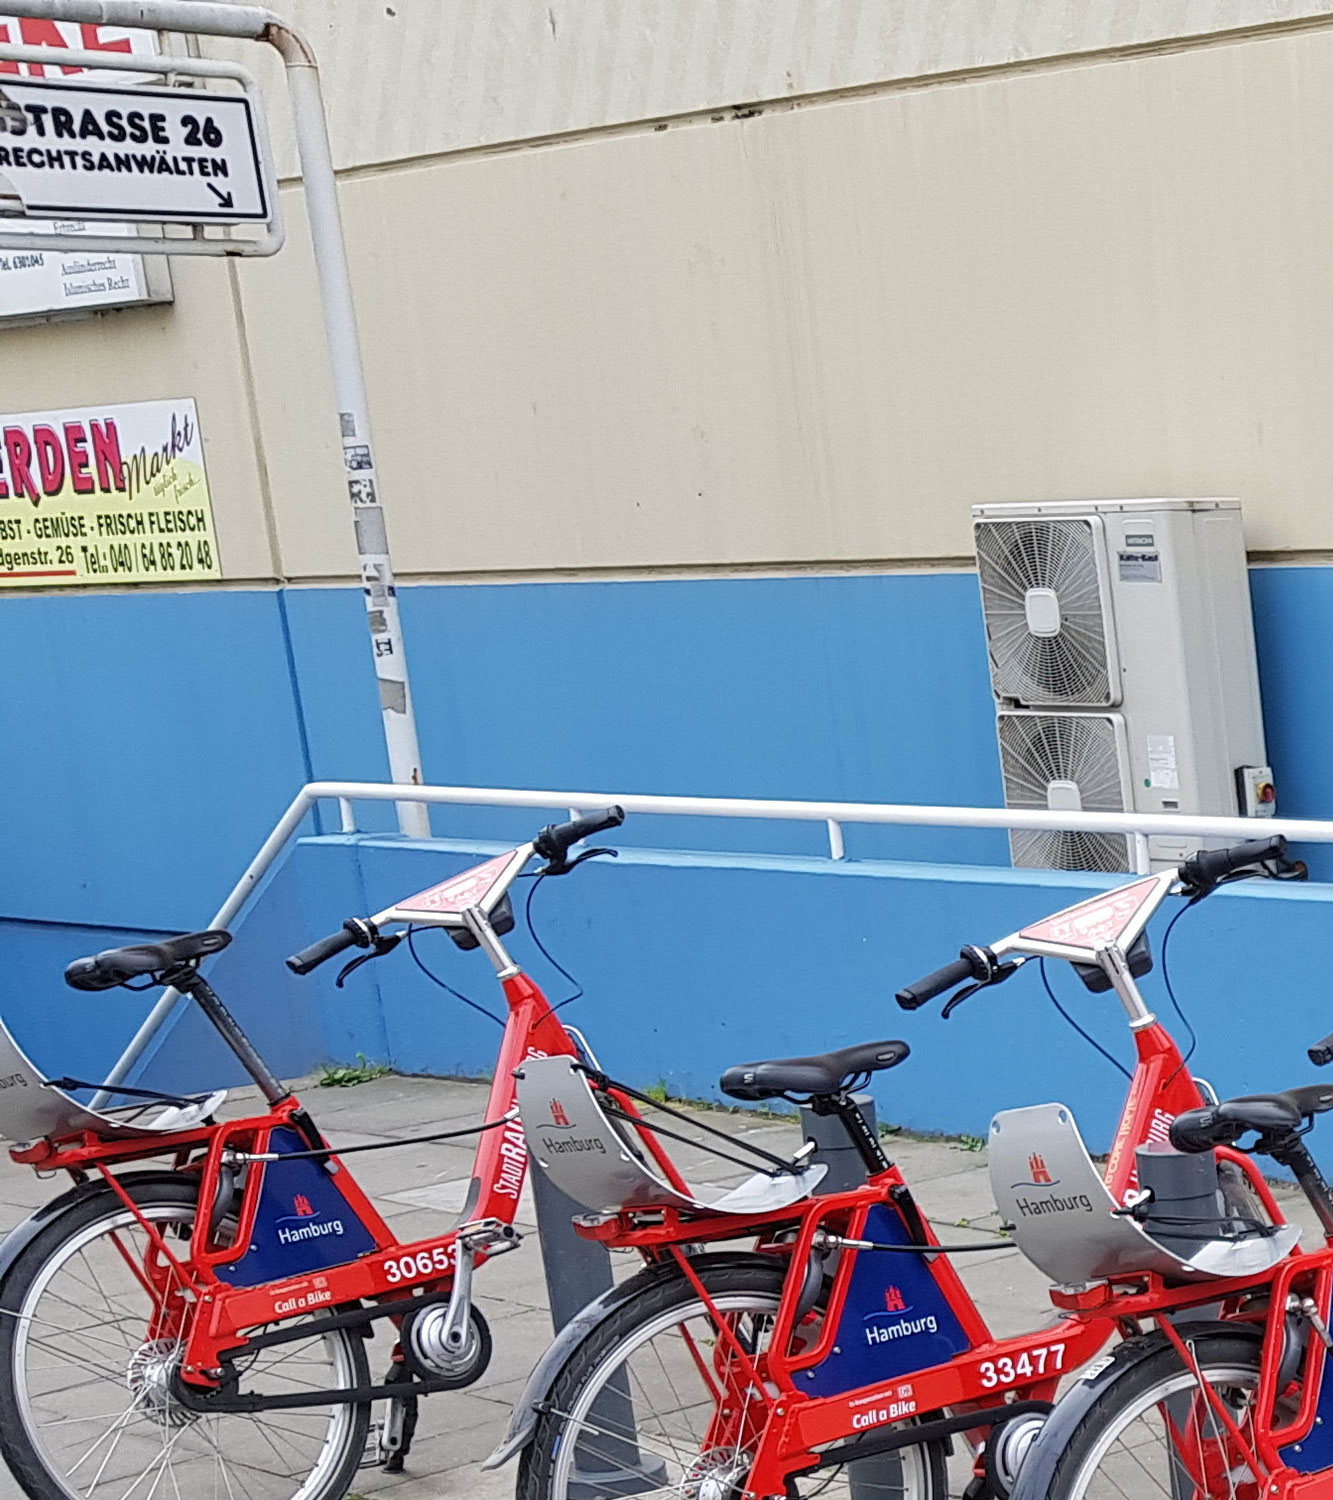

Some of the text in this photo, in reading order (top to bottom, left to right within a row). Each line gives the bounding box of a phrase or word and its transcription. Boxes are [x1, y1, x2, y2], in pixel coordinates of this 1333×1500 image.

[180, 115, 223, 148] 26
[0, 147, 229, 178] RECHTSANWÄLTEN
[120, 412, 194, 501] Markt
[33, 512, 88, 539] GEMÜSE
[97, 512, 146, 537] FRISCH
[150, 509, 207, 534] FLEISCH
[55, 545, 75, 565] 26
[110, 543, 133, 573] 040
[141, 542, 157, 572] 64
[160, 541, 175, 571] 86
[177, 540, 193, 571] 20
[197, 539, 213, 570] 48
[542, 1135, 606, 1155] Hamburg
[1015, 1194, 1093, 1217] Hamburg
[278, 1219, 344, 1245] Hamburg
[274, 1290, 331, 1314] Call a Bike
[865, 1315, 938, 1346] Hamburg
[980, 1343, 1067, 1388] 33477
[852, 1400, 916, 1429] Call a Bike
